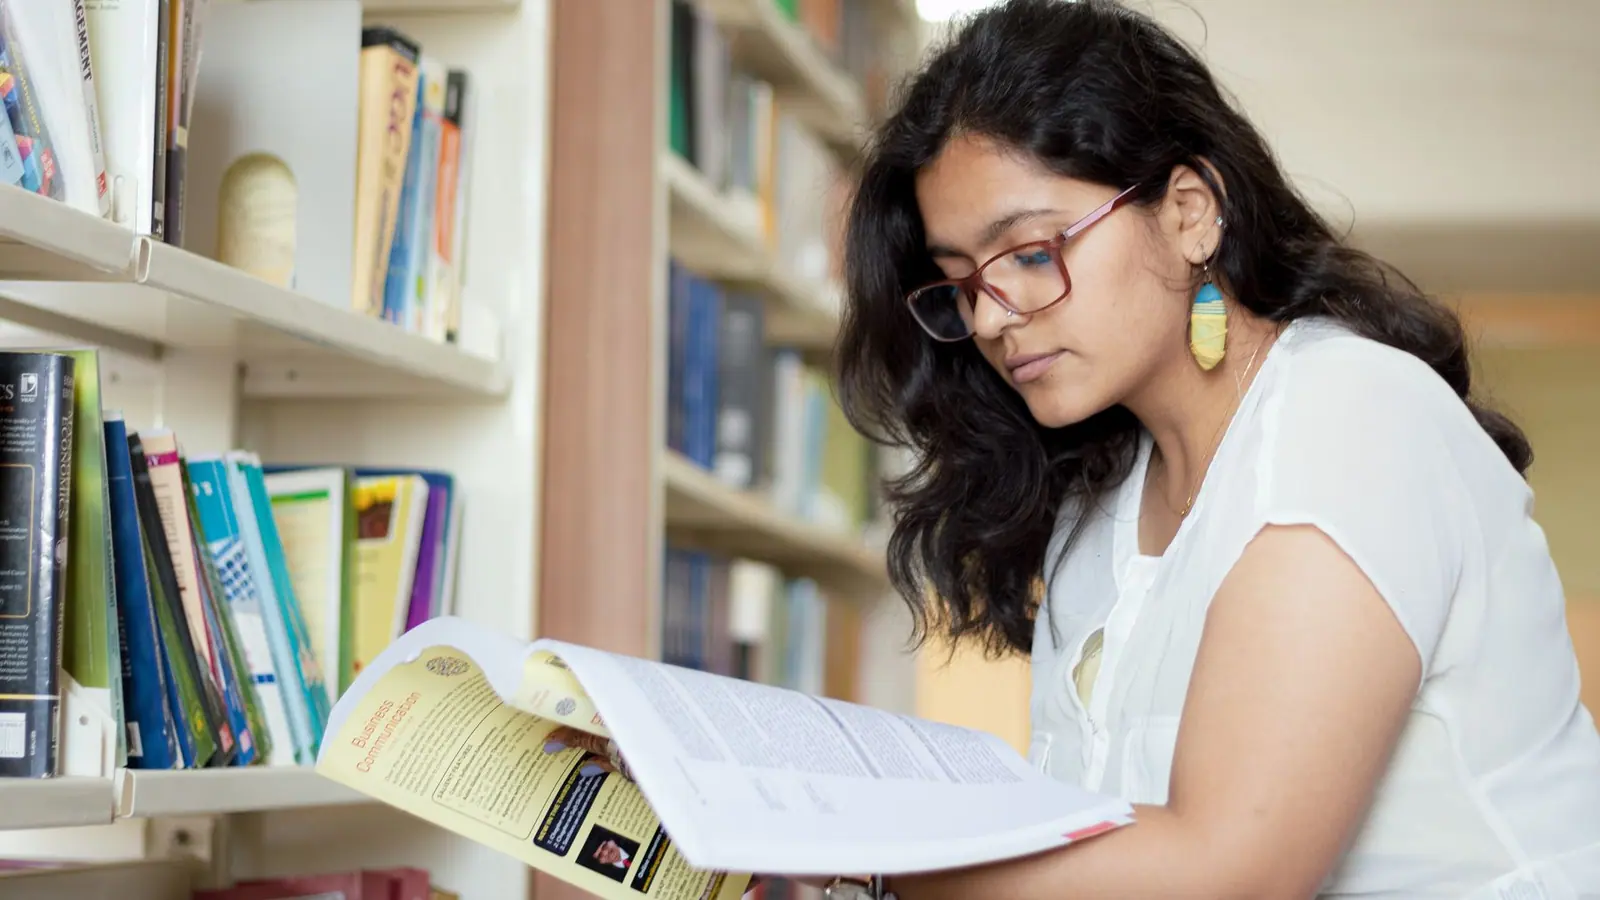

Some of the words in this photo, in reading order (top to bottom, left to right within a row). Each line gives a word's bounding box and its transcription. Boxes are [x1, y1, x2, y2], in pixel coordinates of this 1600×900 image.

[59, 416, 69, 519] ECONOMICS
[350, 699, 394, 748] Business
[356, 691, 421, 772] Communication
